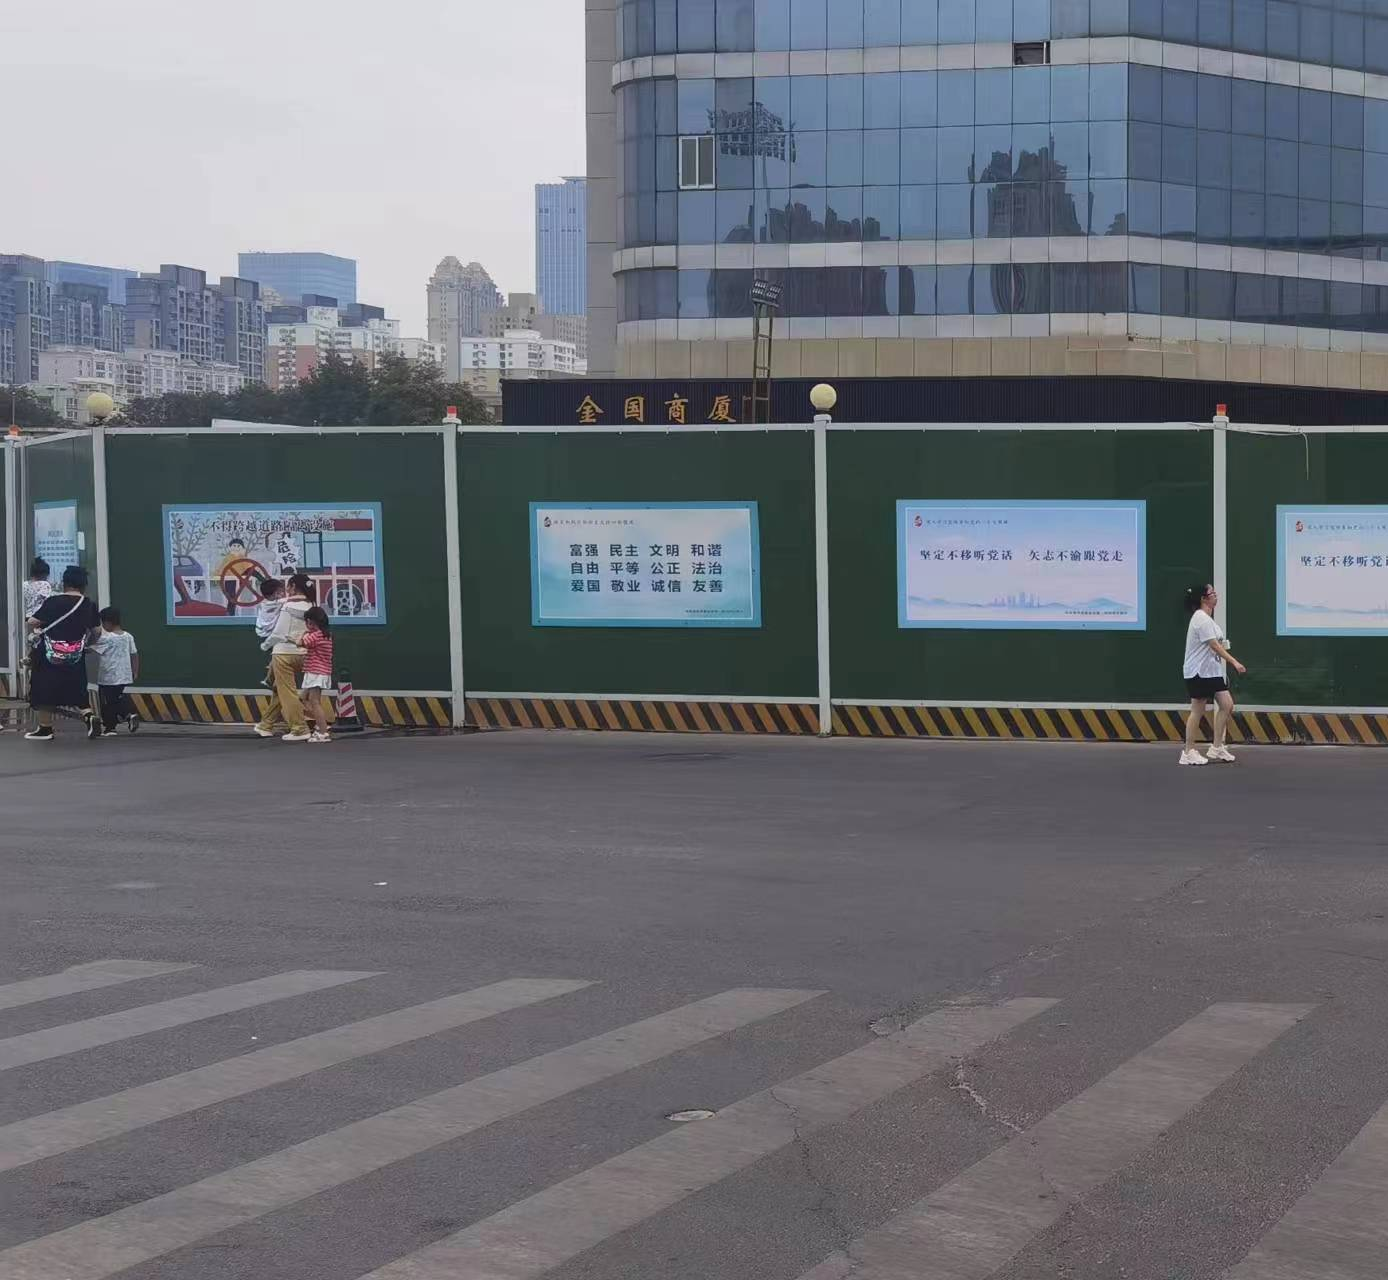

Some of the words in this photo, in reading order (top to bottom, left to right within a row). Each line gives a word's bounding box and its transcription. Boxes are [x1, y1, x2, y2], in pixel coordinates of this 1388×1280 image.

[576, 393, 737, 424] 金国商厦
[570, 544, 599, 557] 富强
[610, 544, 639, 557] 民主
[649, 544, 680, 557] 文明
[691, 544, 722, 557] 和谐
[920, 549, 1013, 562] 坚定不移听党话
[570, 562, 600, 575] 自由
[610, 562, 640, 575] 平等
[651, 562, 681, 575] 公正
[692, 562, 723, 575] 法治
[570, 580, 601, 593] 爱国
[611, 580, 641, 593] 敬业
[651, 580, 682, 593] 诚信
[692, 580, 724, 593] 友善
